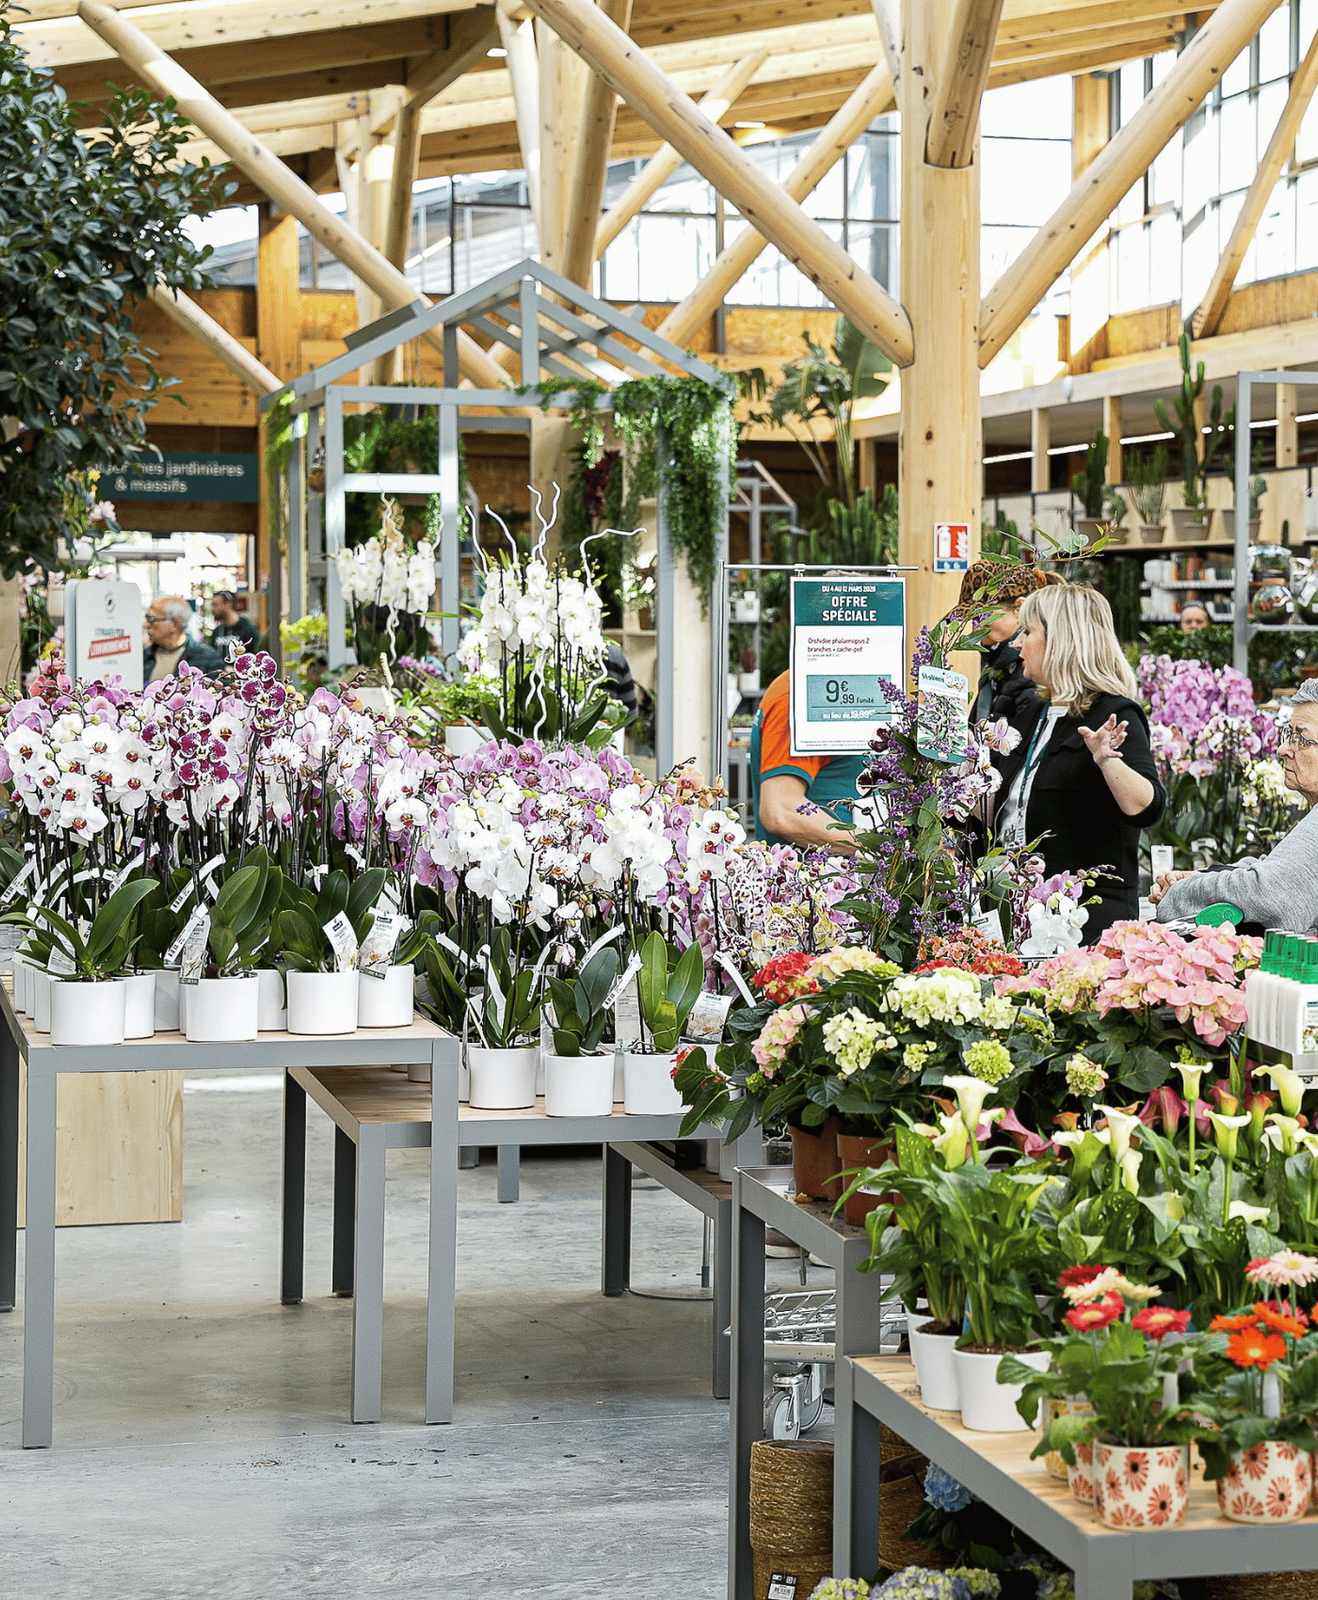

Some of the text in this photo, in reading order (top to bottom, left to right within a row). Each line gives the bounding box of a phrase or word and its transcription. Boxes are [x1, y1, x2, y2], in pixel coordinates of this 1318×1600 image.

[165, 460, 244, 477] jardinières
[115, 476, 188, 492] & massifs
[821, 585, 829, 593] DU
[829, 585, 834, 593] 4
[834, 585, 842, 593] AU
[848, 585, 862, 593] MARS
[831, 595, 868, 607] OFFRE
[822, 607, 877, 622] SPÉCIALE
[807, 637, 831, 645] Orchidée
[836, 646, 863, 654] cache-pot
[826, 679, 849, 703] 9 €
[830, 711, 841, 719] lieu
